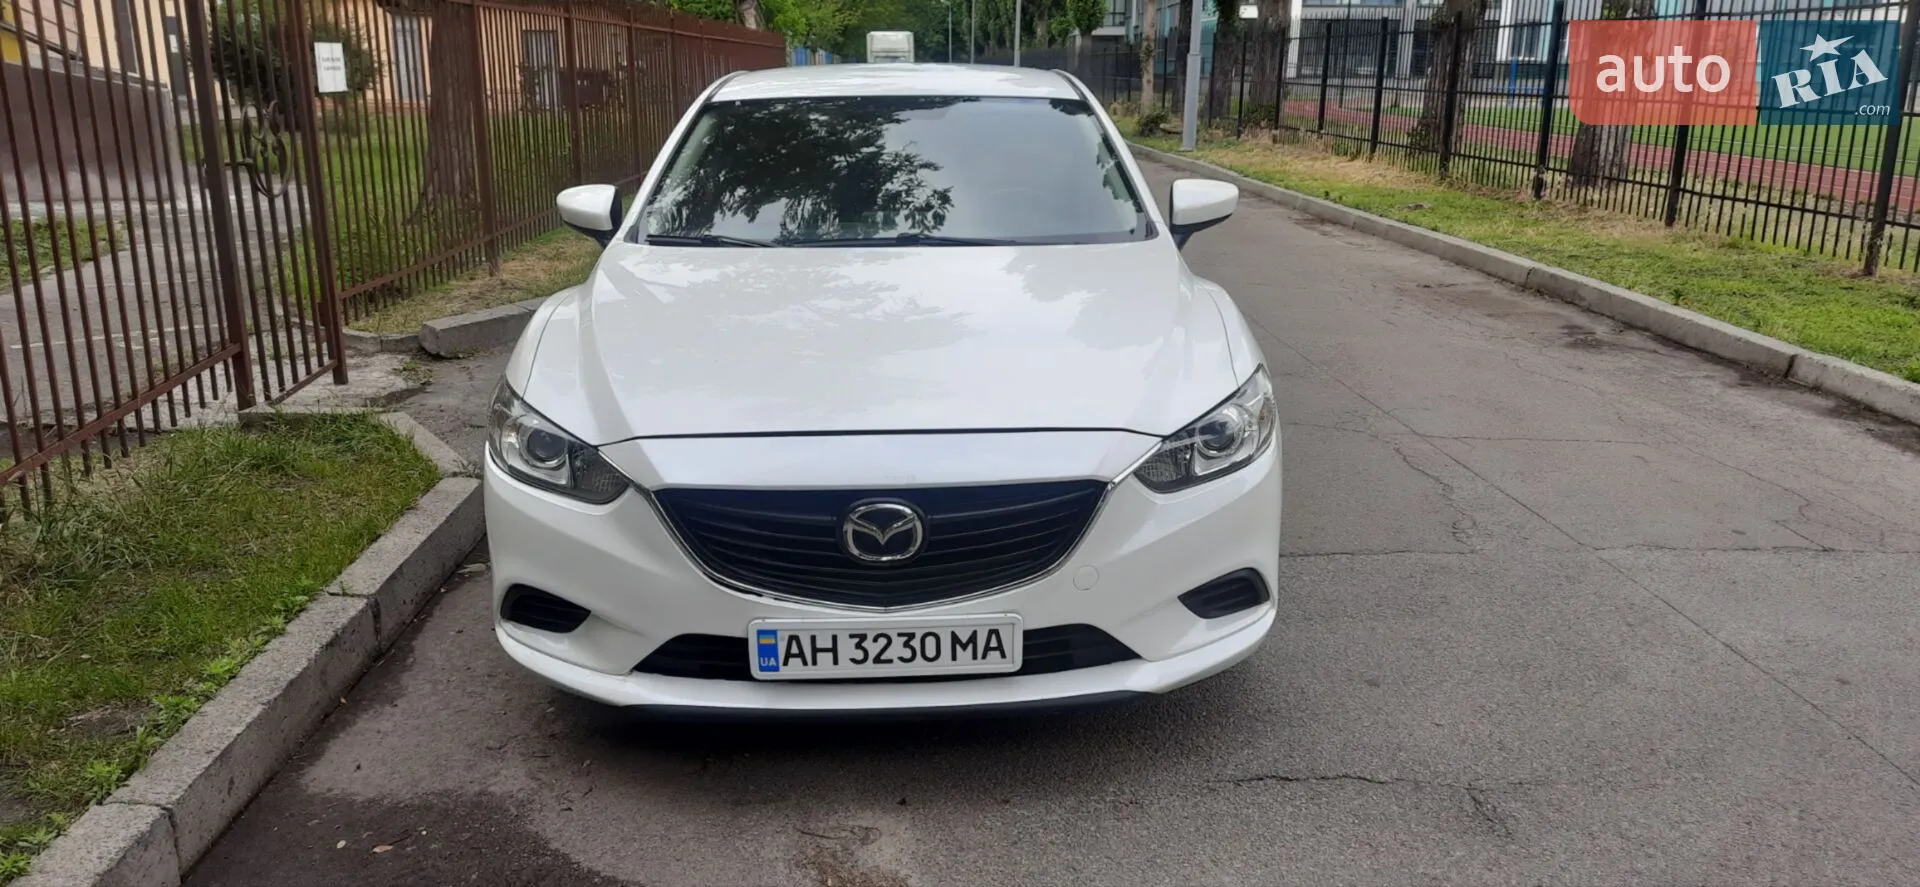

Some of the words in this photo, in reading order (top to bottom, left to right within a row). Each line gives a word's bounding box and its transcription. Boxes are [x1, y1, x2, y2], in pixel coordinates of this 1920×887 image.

[782, 634, 839, 667] AH
[848, 631, 941, 665] 3230
[950, 628, 1007, 662] MA
[760, 657, 777, 667] UA
